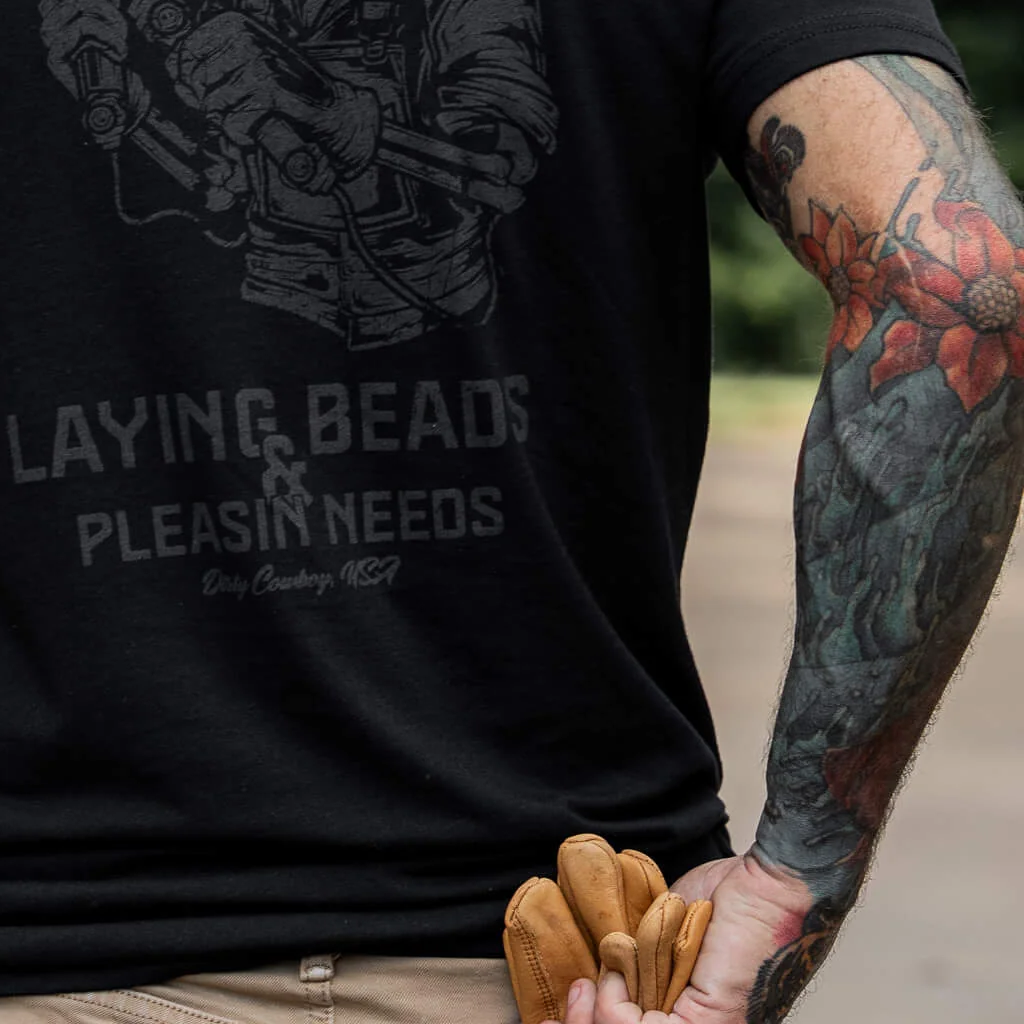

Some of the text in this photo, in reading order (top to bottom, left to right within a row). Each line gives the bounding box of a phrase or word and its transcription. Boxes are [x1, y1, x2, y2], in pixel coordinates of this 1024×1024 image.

[6, 374, 531, 485] LAYING BEADS
[261, 433, 313, 506] &
[76, 486, 506, 568] PLEASIN NEEDS
[340, 555, 401, 588] USA
